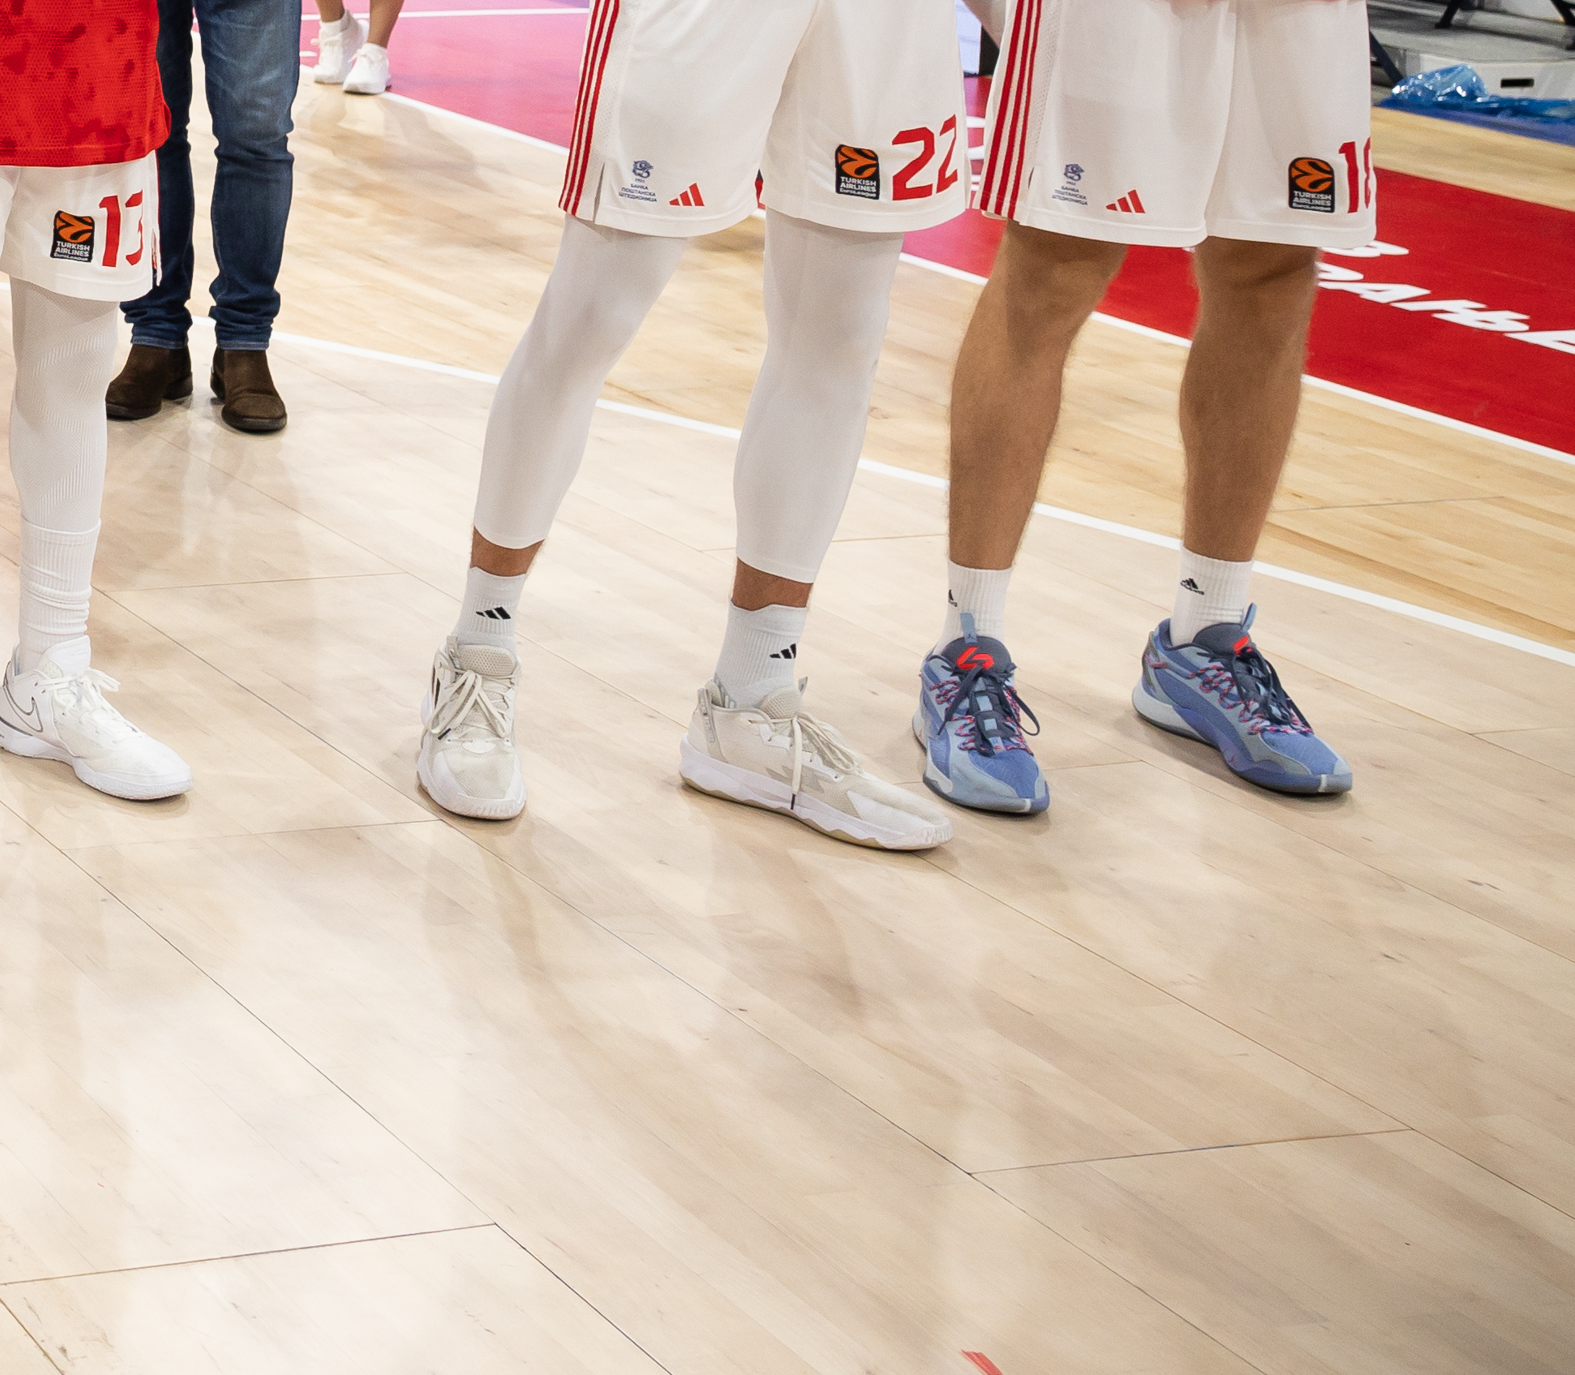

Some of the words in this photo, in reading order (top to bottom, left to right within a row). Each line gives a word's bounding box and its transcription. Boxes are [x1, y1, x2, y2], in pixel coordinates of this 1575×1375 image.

[891, 113, 959, 201] 22
[840, 176, 876, 186] TURKISH
[840, 183, 876, 192] AIRLINES
[1294, 191, 1331, 200] TURKISH
[1294, 197, 1331, 206] AIRLINES
[55, 246, 89, 256] AIRLINES
[56, 241, 90, 251] TURKISH
